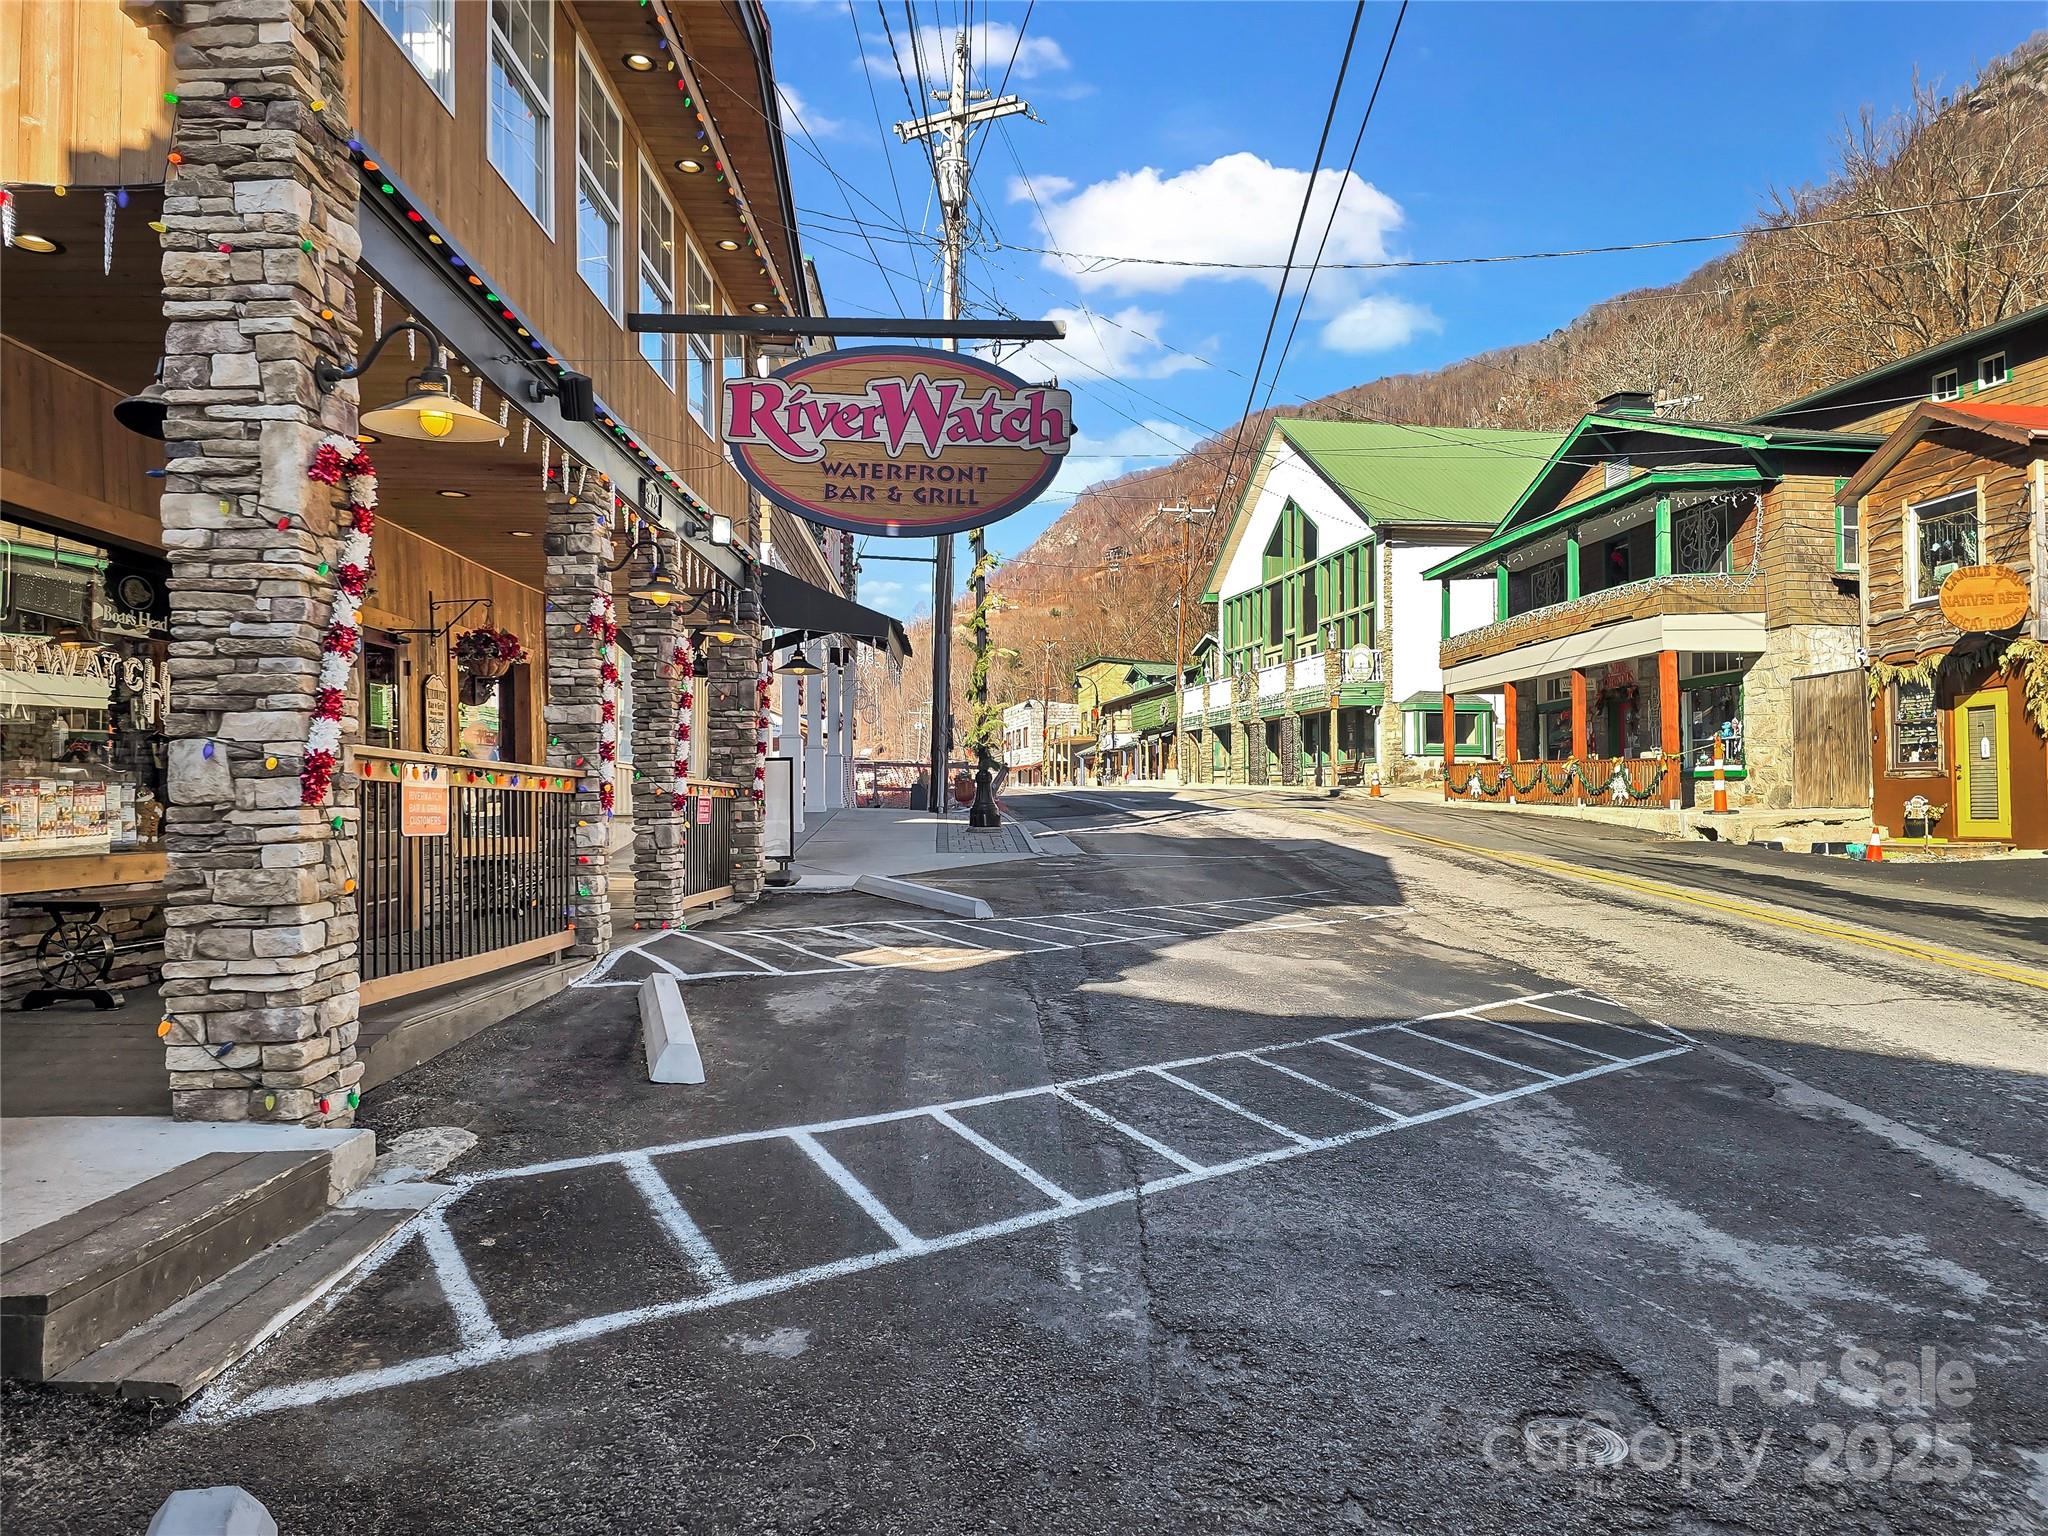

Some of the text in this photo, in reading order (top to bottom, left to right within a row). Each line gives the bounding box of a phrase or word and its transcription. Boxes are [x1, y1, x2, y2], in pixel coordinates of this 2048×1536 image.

[726, 377, 1068, 458] RiverWatch
[820, 460, 988, 484] WATERFRONT
[823, 483, 979, 506] BAR & GRILL
[1944, 566, 1990, 592] CANDLE
[1996, 566, 2025, 588] SHOP
[1941, 591, 2026, 608] NATIVES REST
[103, 604, 168, 632] Boar's Head
[1948, 606, 2023, 630] LOCAL GOODS
[410, 815, 441, 825] CUSTOMERS
